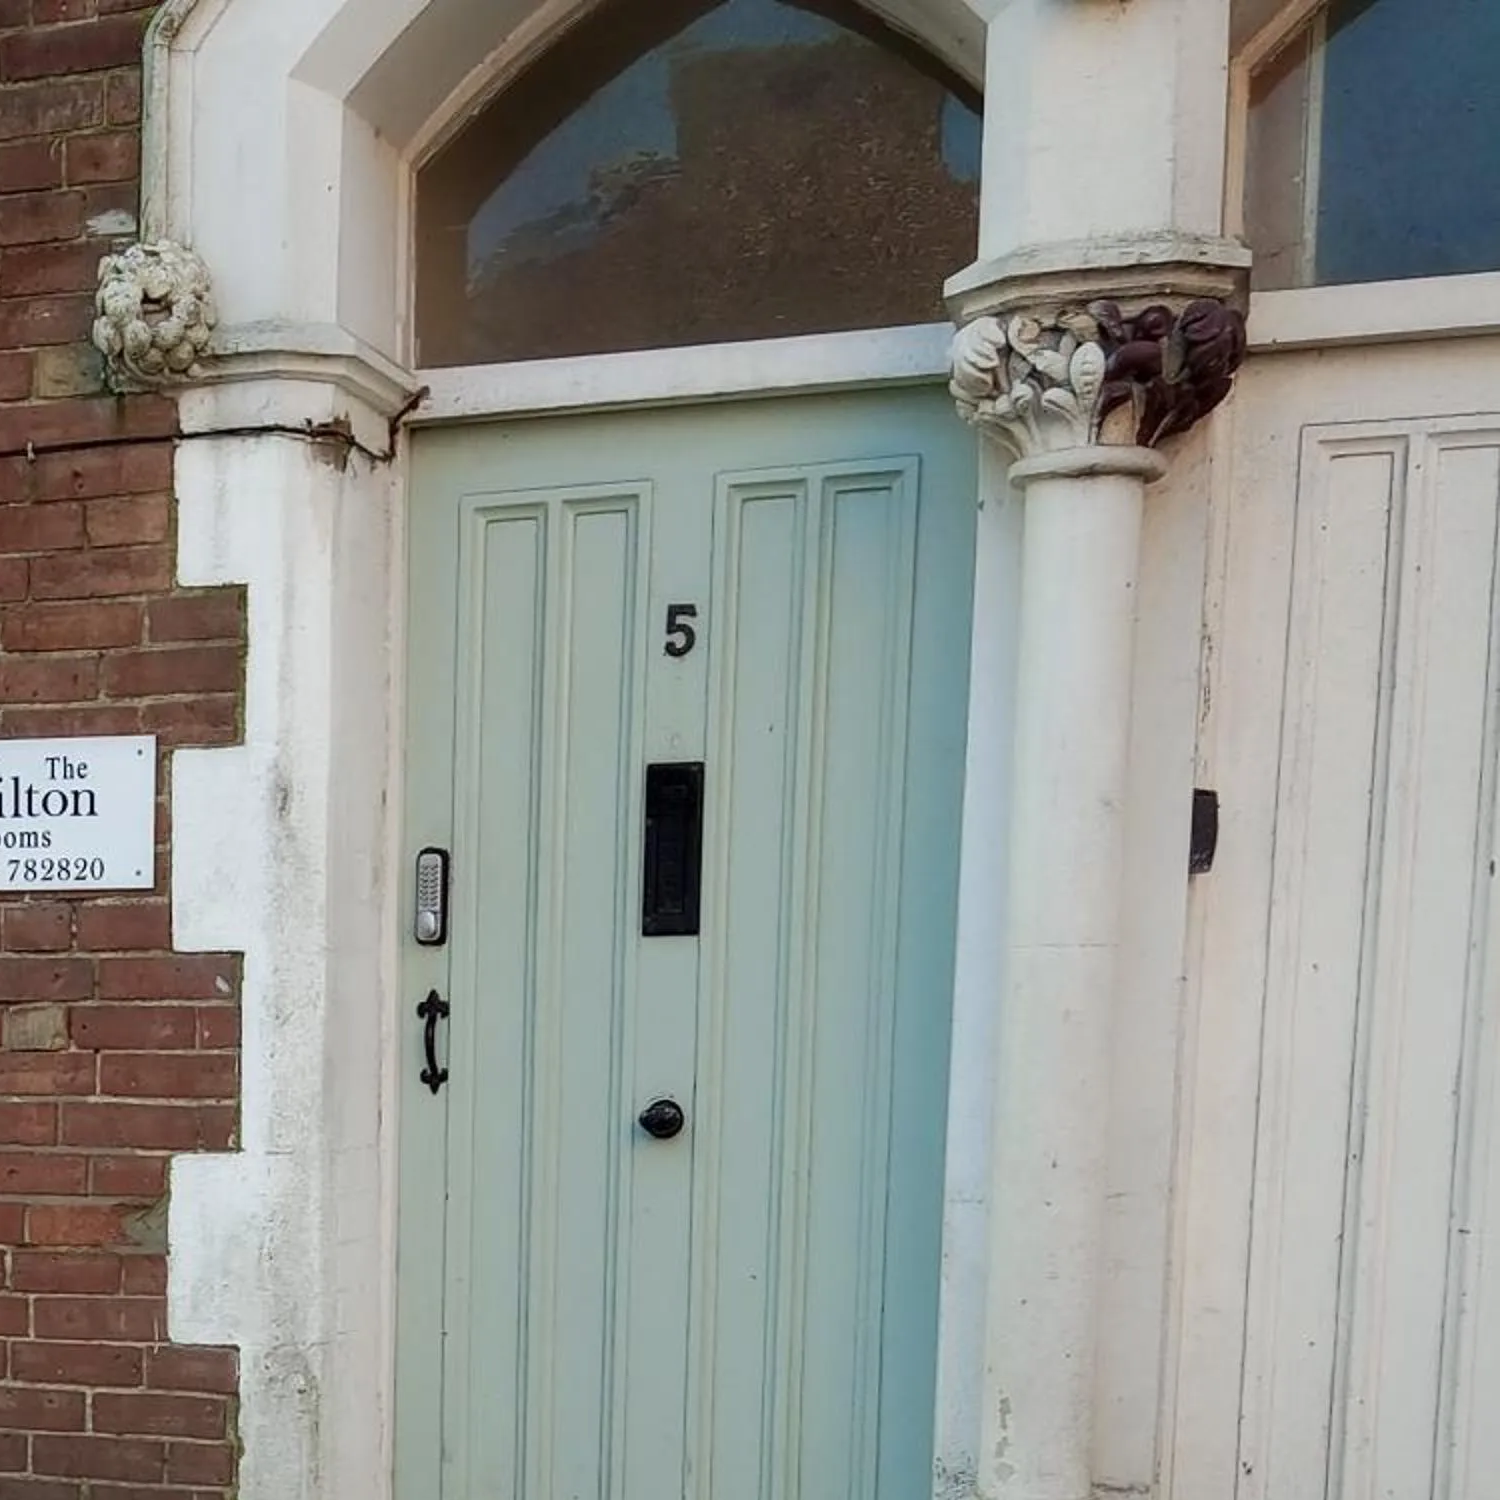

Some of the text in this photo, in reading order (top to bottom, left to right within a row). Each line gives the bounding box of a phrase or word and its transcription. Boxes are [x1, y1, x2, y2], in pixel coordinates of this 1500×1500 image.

[666, 604, 697, 657] 5
[45, 757, 87, 780] The
[8, 858, 104, 882] 782820
